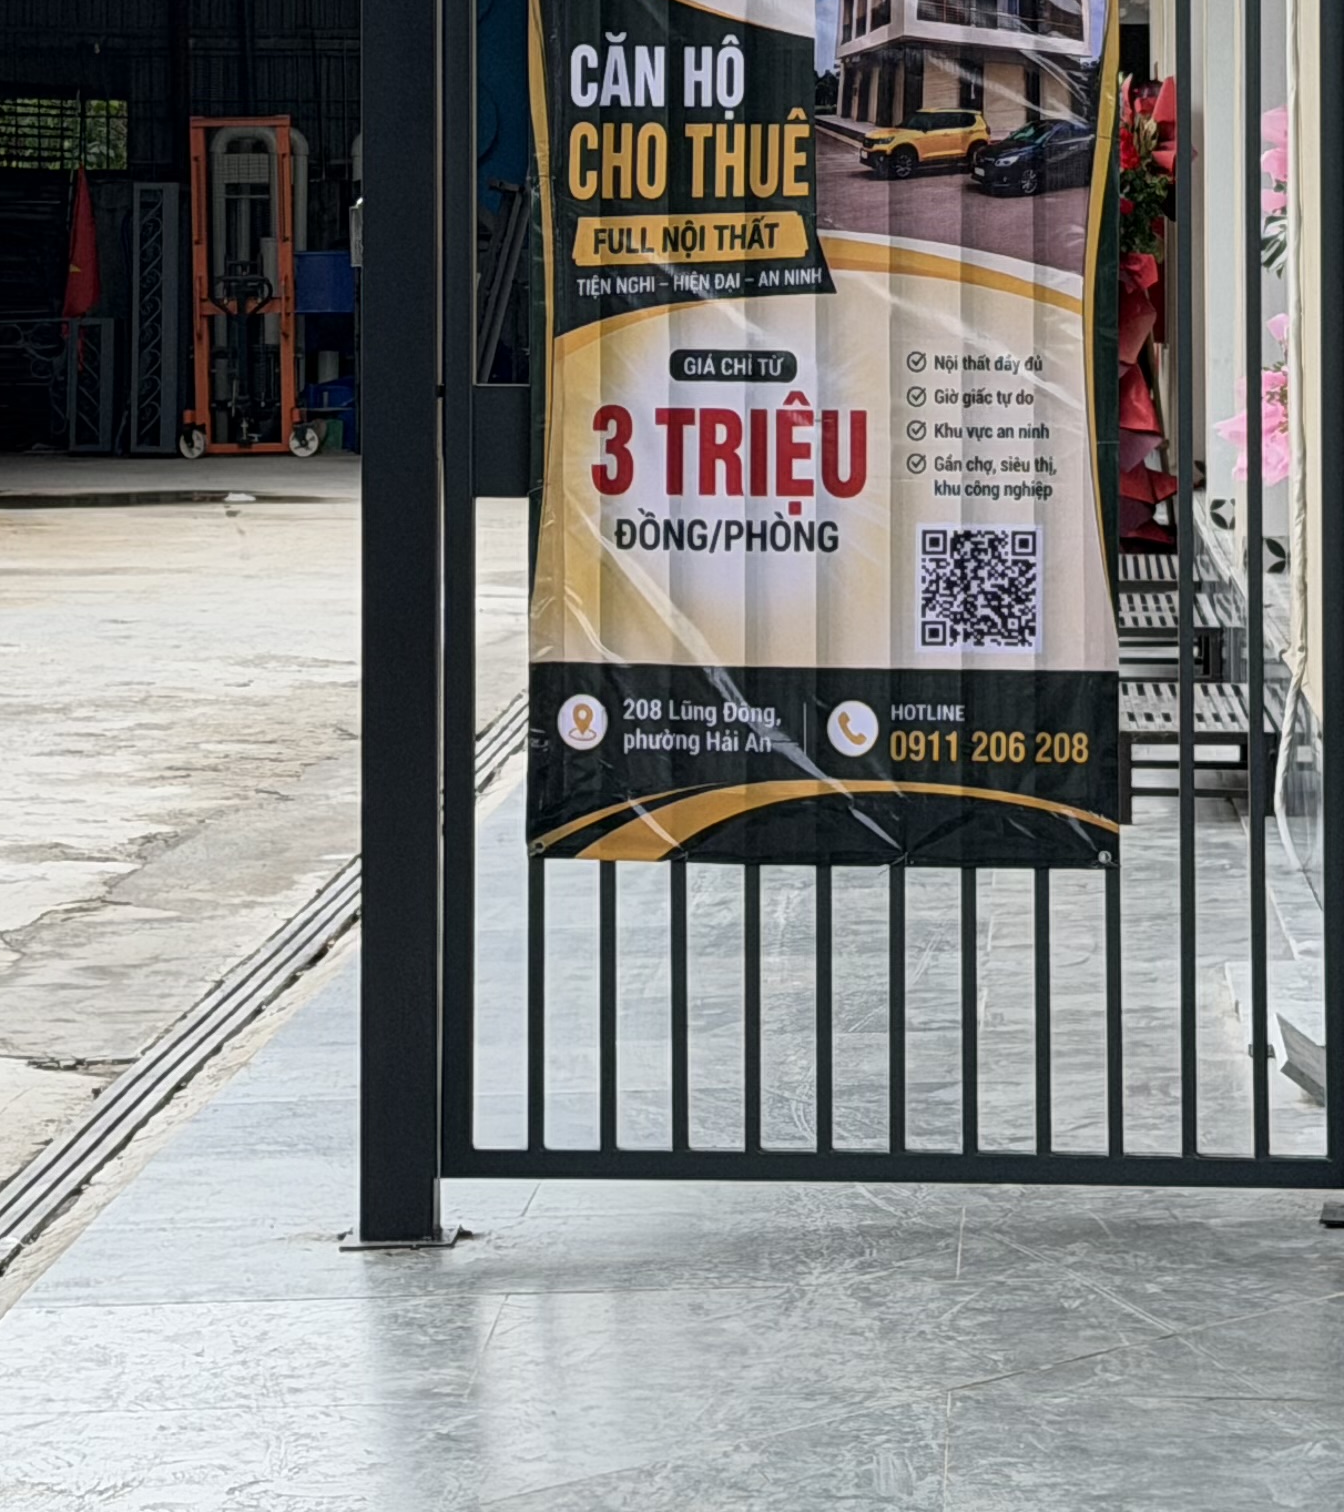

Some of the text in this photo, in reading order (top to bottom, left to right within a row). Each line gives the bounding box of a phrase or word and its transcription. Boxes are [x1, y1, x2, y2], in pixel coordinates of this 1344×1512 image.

[570, 31, 745, 121] CĂN HỘ
[568, 107, 811, 201] CHO THUÊ
[593, 215, 780, 259] FULL NỘI THẤT
[577, 275, 611, 299] TIỆN
[616, 276, 656, 294] NGHI
[673, 270, 710, 293] HIỆN
[715, 272, 741, 293] ĐẠI
[758, 270, 780, 288] AN
[784, 267, 823, 286] NINH
[683, 353, 785, 377] GIÁ CHỈ TỪ
[934, 354, 959, 374] Nội
[963, 353, 991, 372] thất
[1024, 355, 1044, 372] đủ
[934, 387, 1034, 408] Giờ giấc tự do
[934, 422, 1050, 442] Khu vực an ninh
[591, 390, 867, 516] 3 TRIỆU
[966, 456, 997, 476] chợ,
[1000, 457, 1030, 473] siêu
[1034, 456, 1057, 476] thị,
[934, 480, 1053, 502] khu công nghiệp
[614, 507, 839, 554] ĐỒNG/PHÒNG
[622, 698, 782, 727] 208 Lũng Đông,
[890, 703, 966, 722] HOTLINE
[623, 728, 772, 756] phường Hải An
[889, 730, 1089, 764] 0911 206 208
